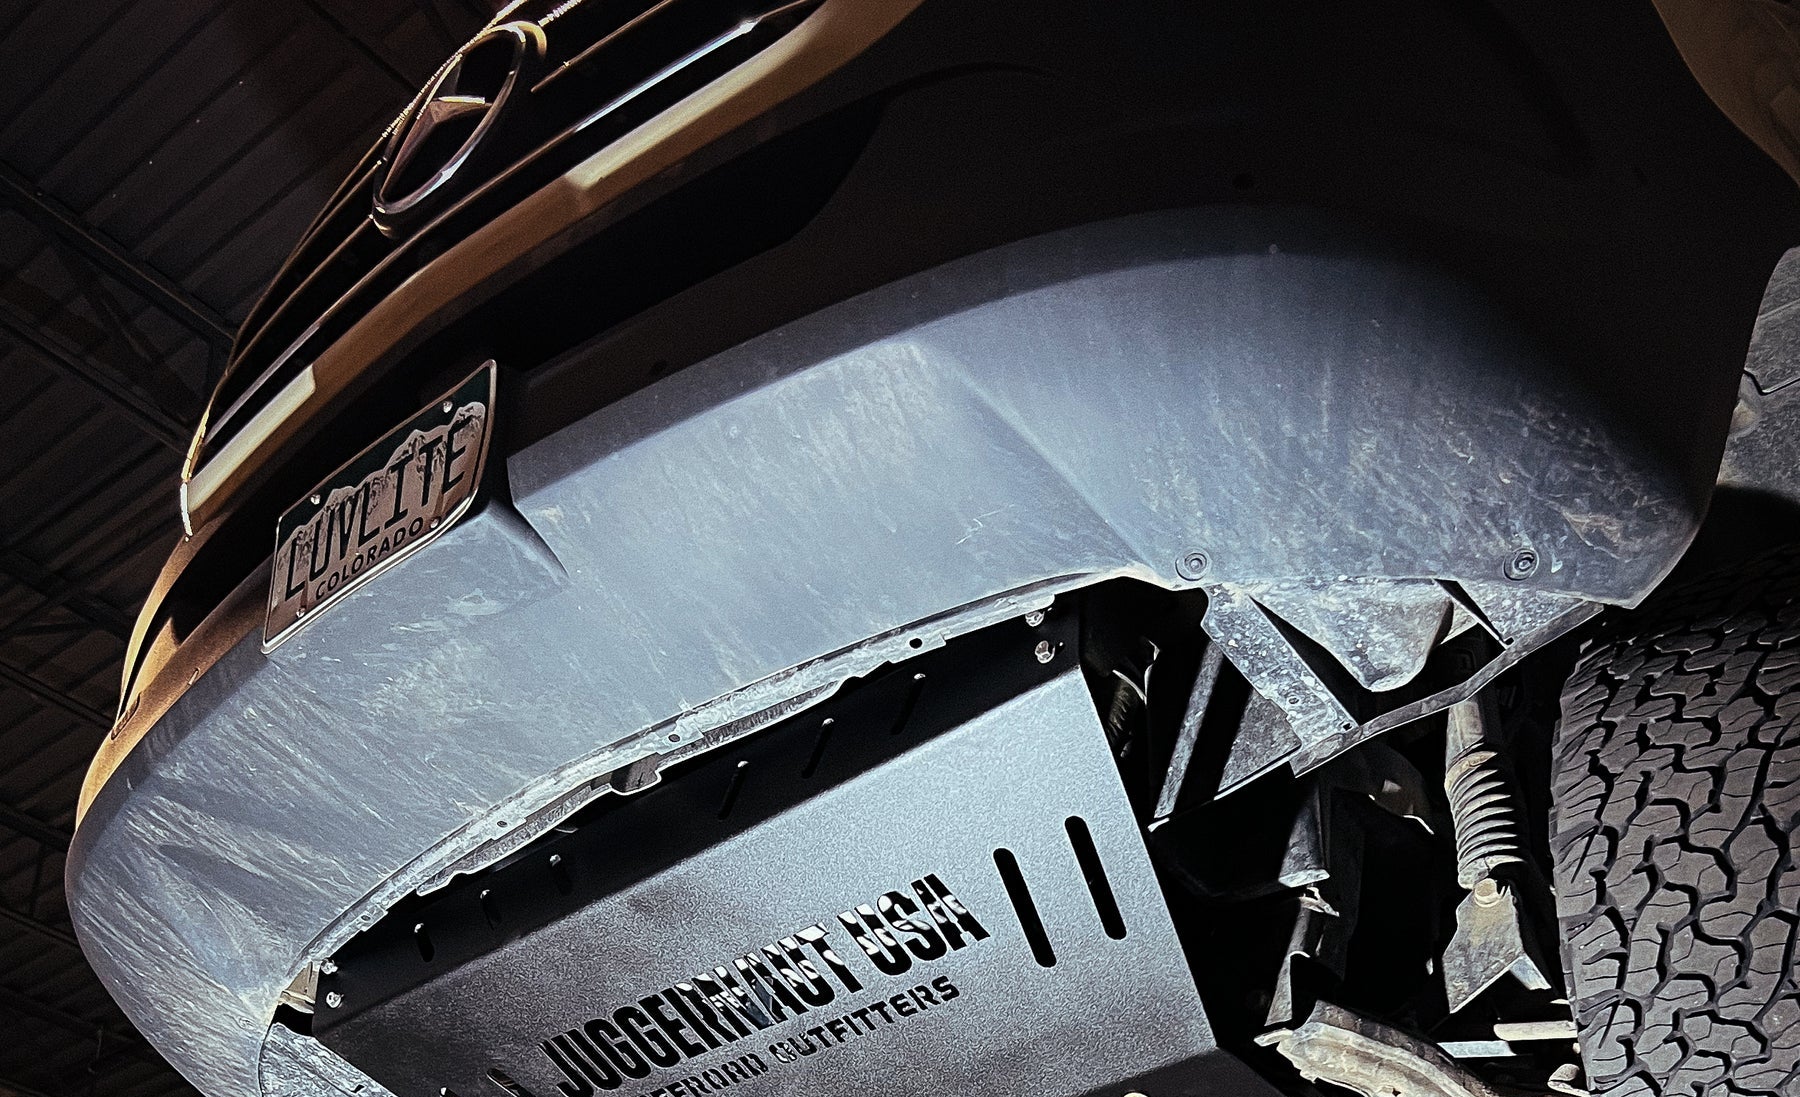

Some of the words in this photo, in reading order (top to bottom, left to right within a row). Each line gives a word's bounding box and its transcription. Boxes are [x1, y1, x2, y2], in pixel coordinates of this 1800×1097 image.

[285, 414, 475, 602] LUVLITE
[315, 516, 423, 600] COLORADO
[836, 873, 991, 976] USA
[768, 975, 960, 1063] OUTFITTERS
